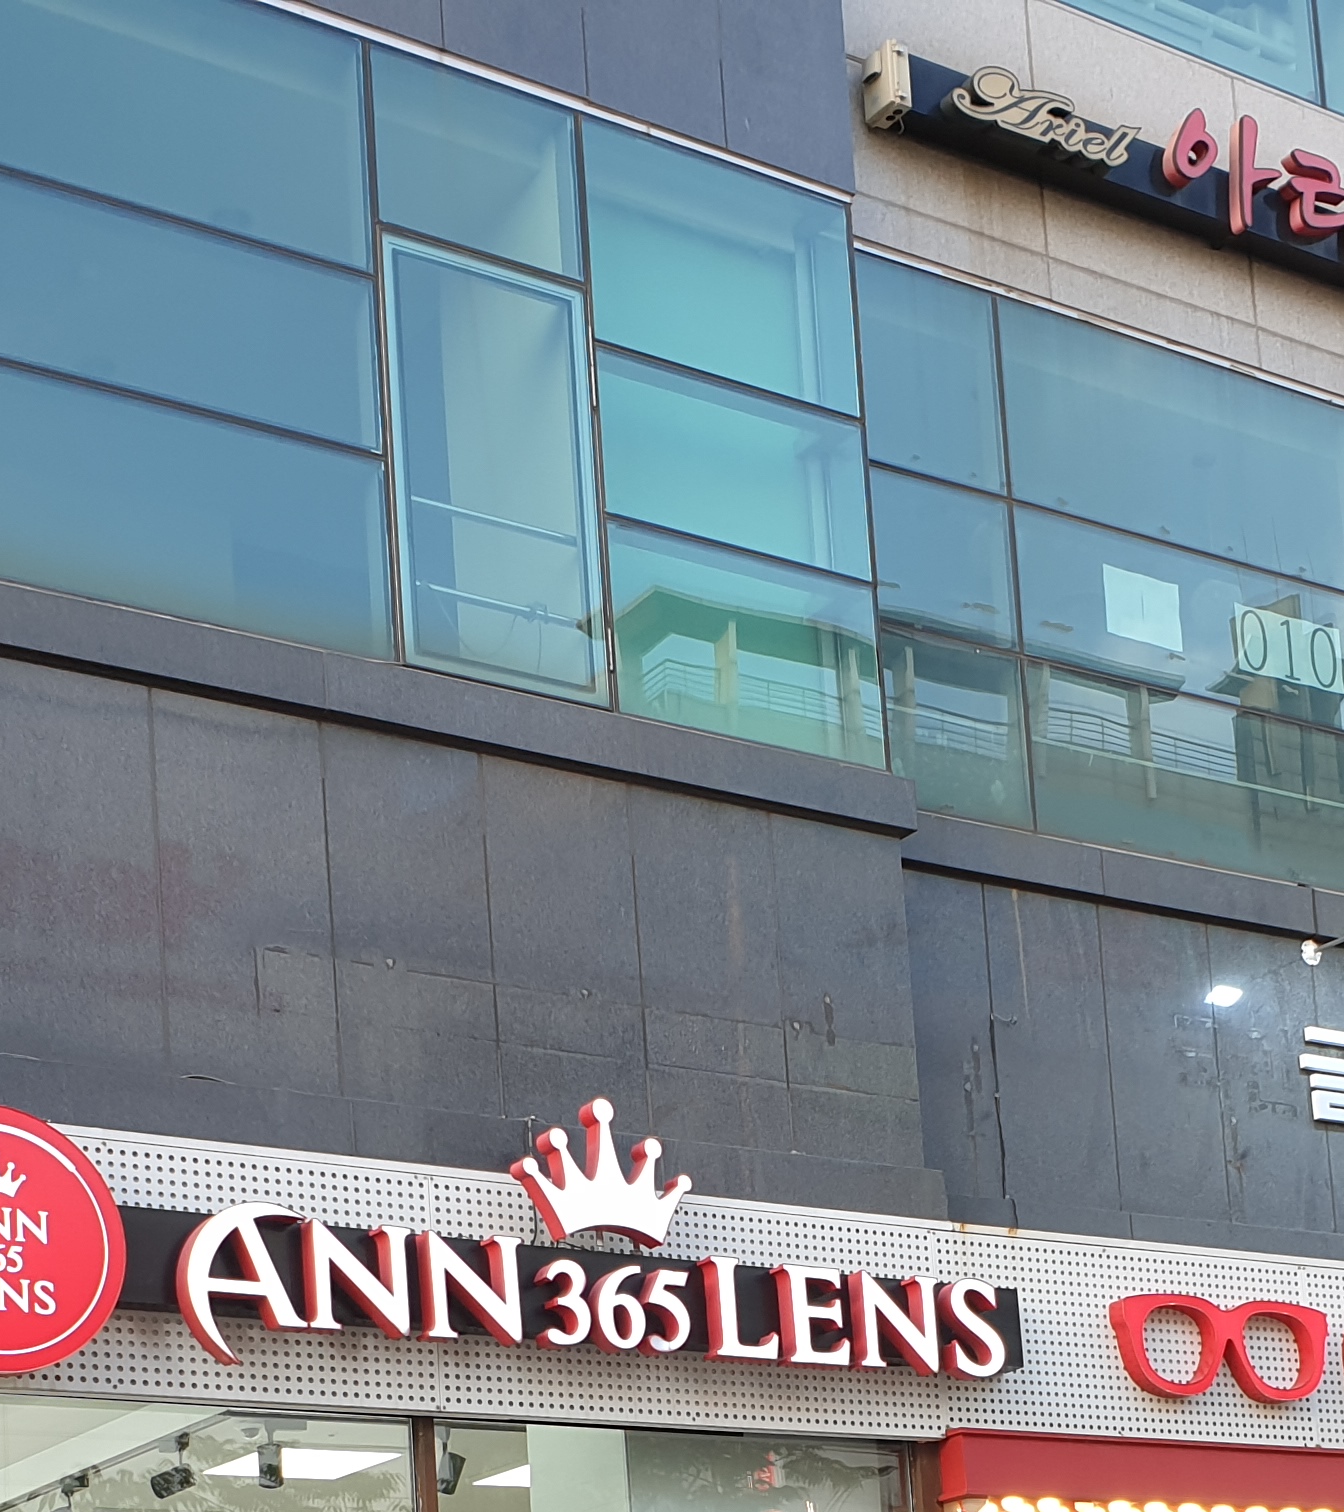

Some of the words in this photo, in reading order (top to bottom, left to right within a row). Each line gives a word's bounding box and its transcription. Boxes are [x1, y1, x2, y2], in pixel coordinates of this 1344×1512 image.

[952, 66, 1143, 167] Ariel
[1238, 609, 1338, 692] 010
[174, 1200, 524, 1367] ANN
[532, 1256, 692, 1356] 365
[700, 1254, 1012, 1381] LENS
